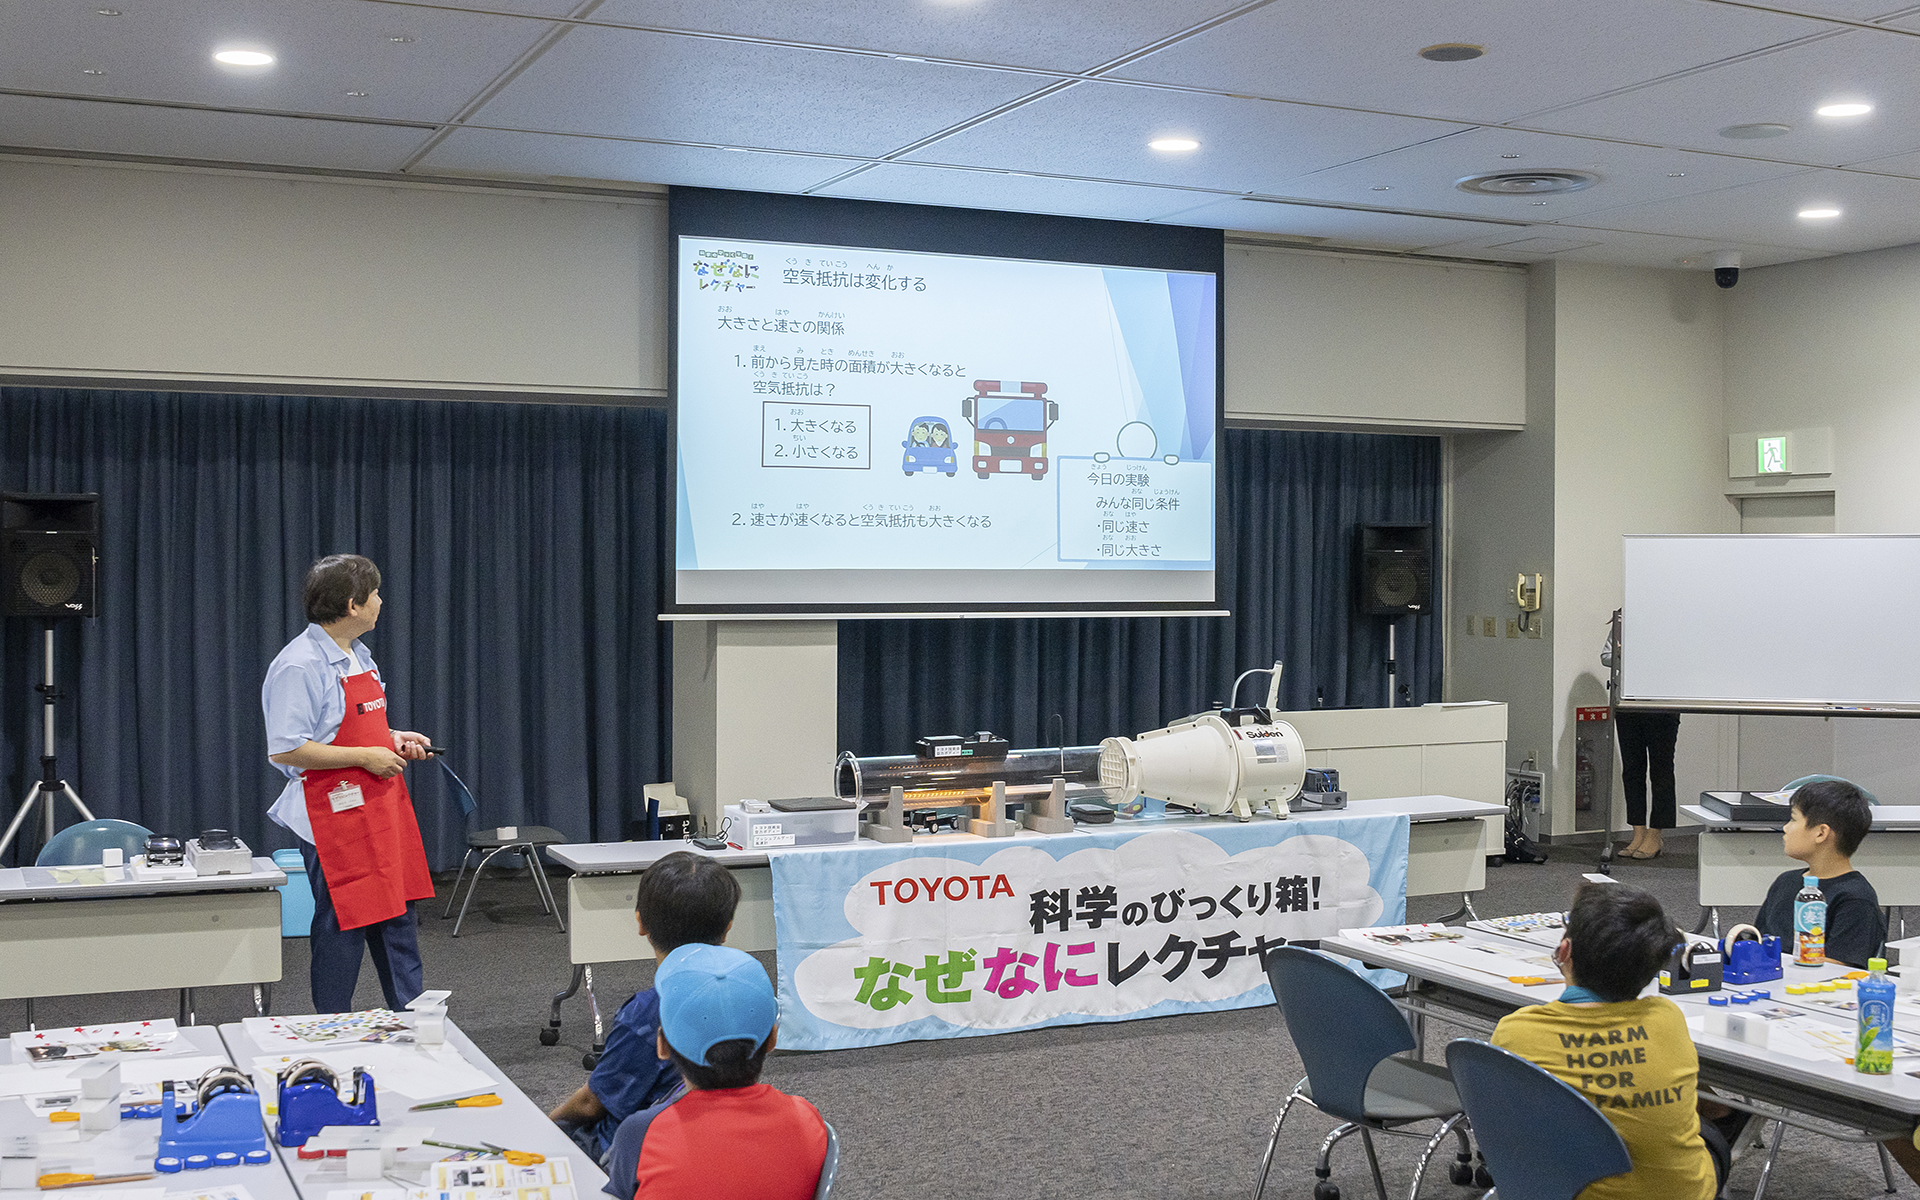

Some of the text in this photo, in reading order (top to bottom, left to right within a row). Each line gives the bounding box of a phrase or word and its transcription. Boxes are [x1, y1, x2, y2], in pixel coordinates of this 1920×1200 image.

[693, 259, 759, 279] なぜなに
[700, 279, 756, 292] レクチャー
[782, 268, 927, 293] 空気抵抗は変化する
[717, 305, 733, 313] おお
[717, 316, 845, 336] 大きさと速さの関係
[751, 355, 967, 378] 前から見た時の面積が大きくなると
[790, 418, 857, 434] 大きくなる
[792, 444, 858, 460] 小さくなる
[1087, 472, 1150, 487] 今日の実験
[1095, 496, 1180, 511] みんな同じ条件
[750, 512, 993, 529] 速さが速くなると空気抵抗も大きくなる
[870, 873, 1015, 906] TOYOTA
[1029, 876, 1321, 934] 科学のびっくり箱!
[1558, 1025, 1649, 1049] WARM
[1566, 1047, 1647, 1069] HOME
[1581, 1071, 1636, 1090] FOR
[1595, 1085, 1685, 1109] FAMILY
